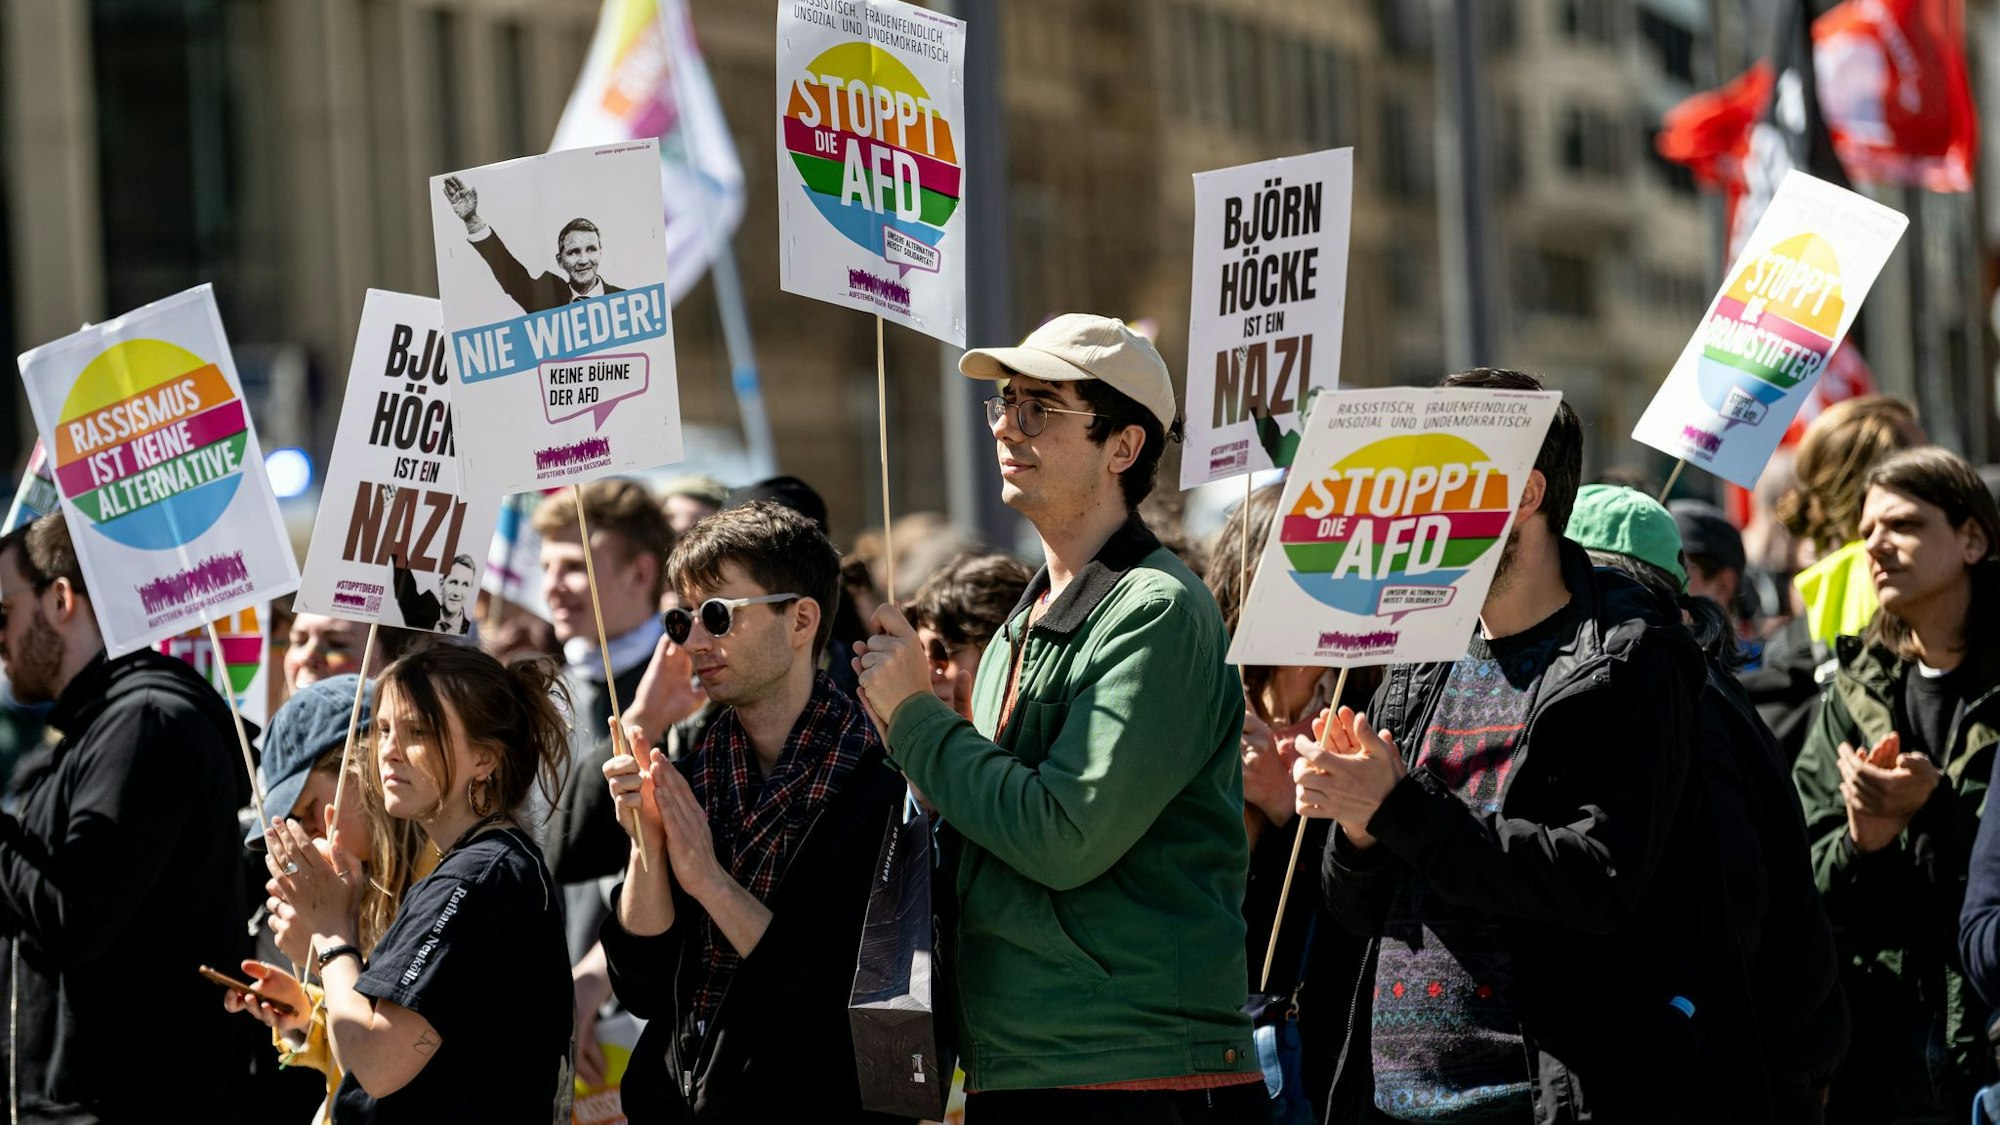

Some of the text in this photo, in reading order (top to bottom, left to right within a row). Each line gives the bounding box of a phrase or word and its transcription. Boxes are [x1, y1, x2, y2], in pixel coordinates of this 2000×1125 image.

[794, 4, 949, 63] UNSOZIAL UND UNDEMOKRATISCH
[795, 70, 942, 156] STOPPT
[814, 130, 922, 223] DIE AFD
[1223, 177, 1323, 249] BJÖRN
[905, 240, 935, 260] ALTERNATIVE
[1219, 246, 1319, 316] HÖCKE
[849, 291, 875, 302] AUFSTEHEN
[1744, 255, 1841, 317] STOPPT
[458, 289, 664, 377] NIE WIEDER!
[1243, 311, 1285, 338] IST EIN
[550, 362, 630, 385] KEINE BÜHNE
[550, 386, 599, 406] DER AFD
[1212, 334, 1313, 429] NAZI
[69, 379, 200, 454] RASSISMUS
[1328, 415, 1532, 429] UNSOZIAL UND UNDEMOKRATISCH
[88, 421, 196, 487] IST KEINE
[98, 441, 240, 521] ALTERNATIVE
[394, 457, 440, 483] IST EIN
[537, 458, 612, 480] AUFSTEHEN GEGEN RASSISMUS
[1304, 461, 1507, 520] STOPPT
[342, 480, 468, 575] NAZI
[1317, 514, 1451, 581] DIE AFD
[882, 826, 899, 882] RAUSCH.DE
[401, 886, 468, 986] Rathaus Neukölln
